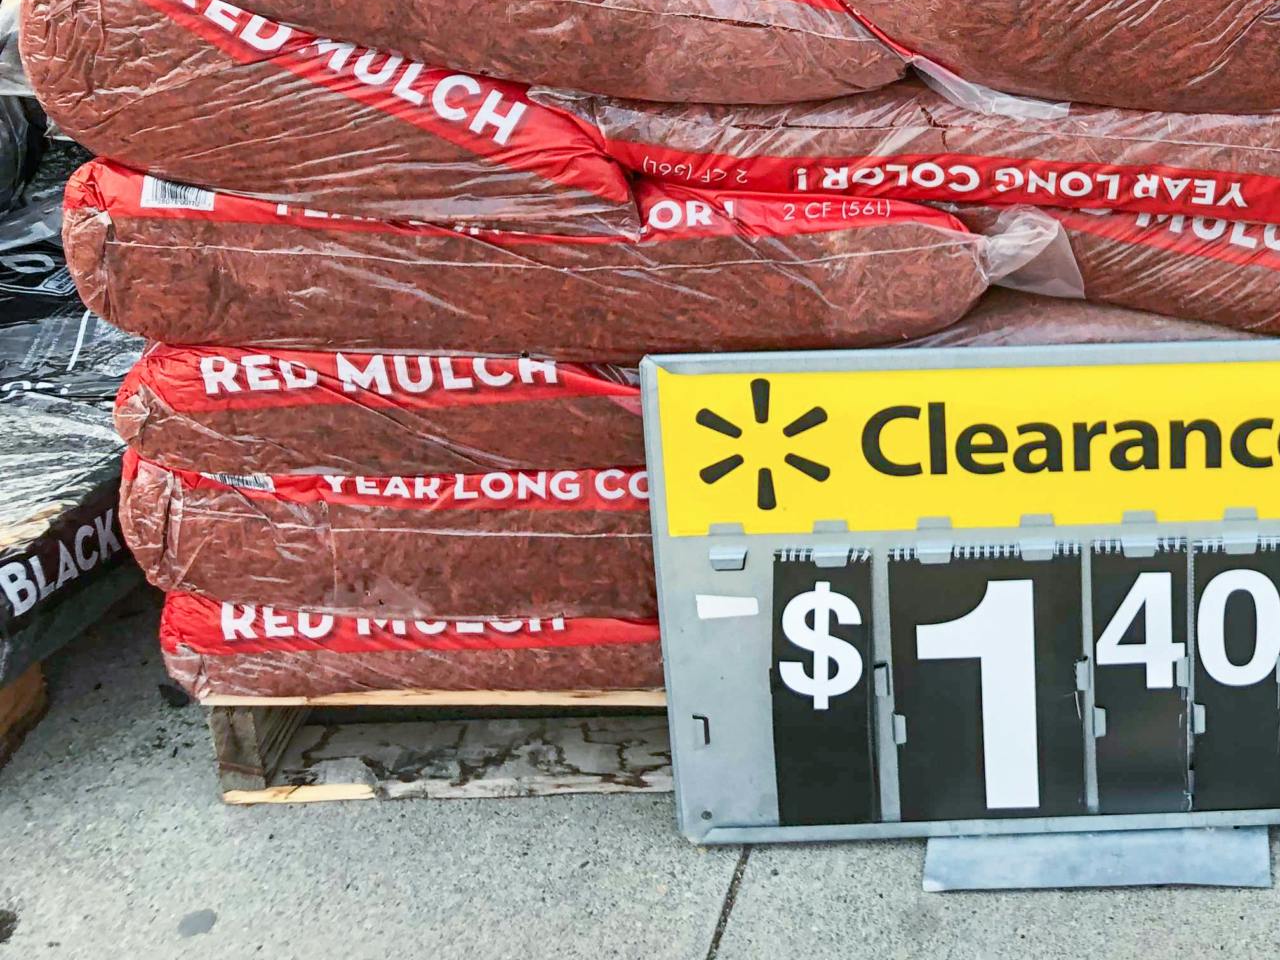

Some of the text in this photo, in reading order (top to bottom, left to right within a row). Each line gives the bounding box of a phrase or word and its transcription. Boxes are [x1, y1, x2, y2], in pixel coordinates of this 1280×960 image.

[299, 37, 528, 145] MULCH
[736, 168, 749, 183] 2
[995, 167, 1118, 201] LONG
[1134, 173, 1250, 208] YEAR
[783, 203, 796, 220] 2
[804, 201, 832, 220] CF
[200, 352, 559, 397] RED MULCH
[322, 472, 442, 500] YEAR
[452, 470, 581, 502] LONG
[0, 508, 123, 617] BLACK
[221, 602, 334, 642] RED
